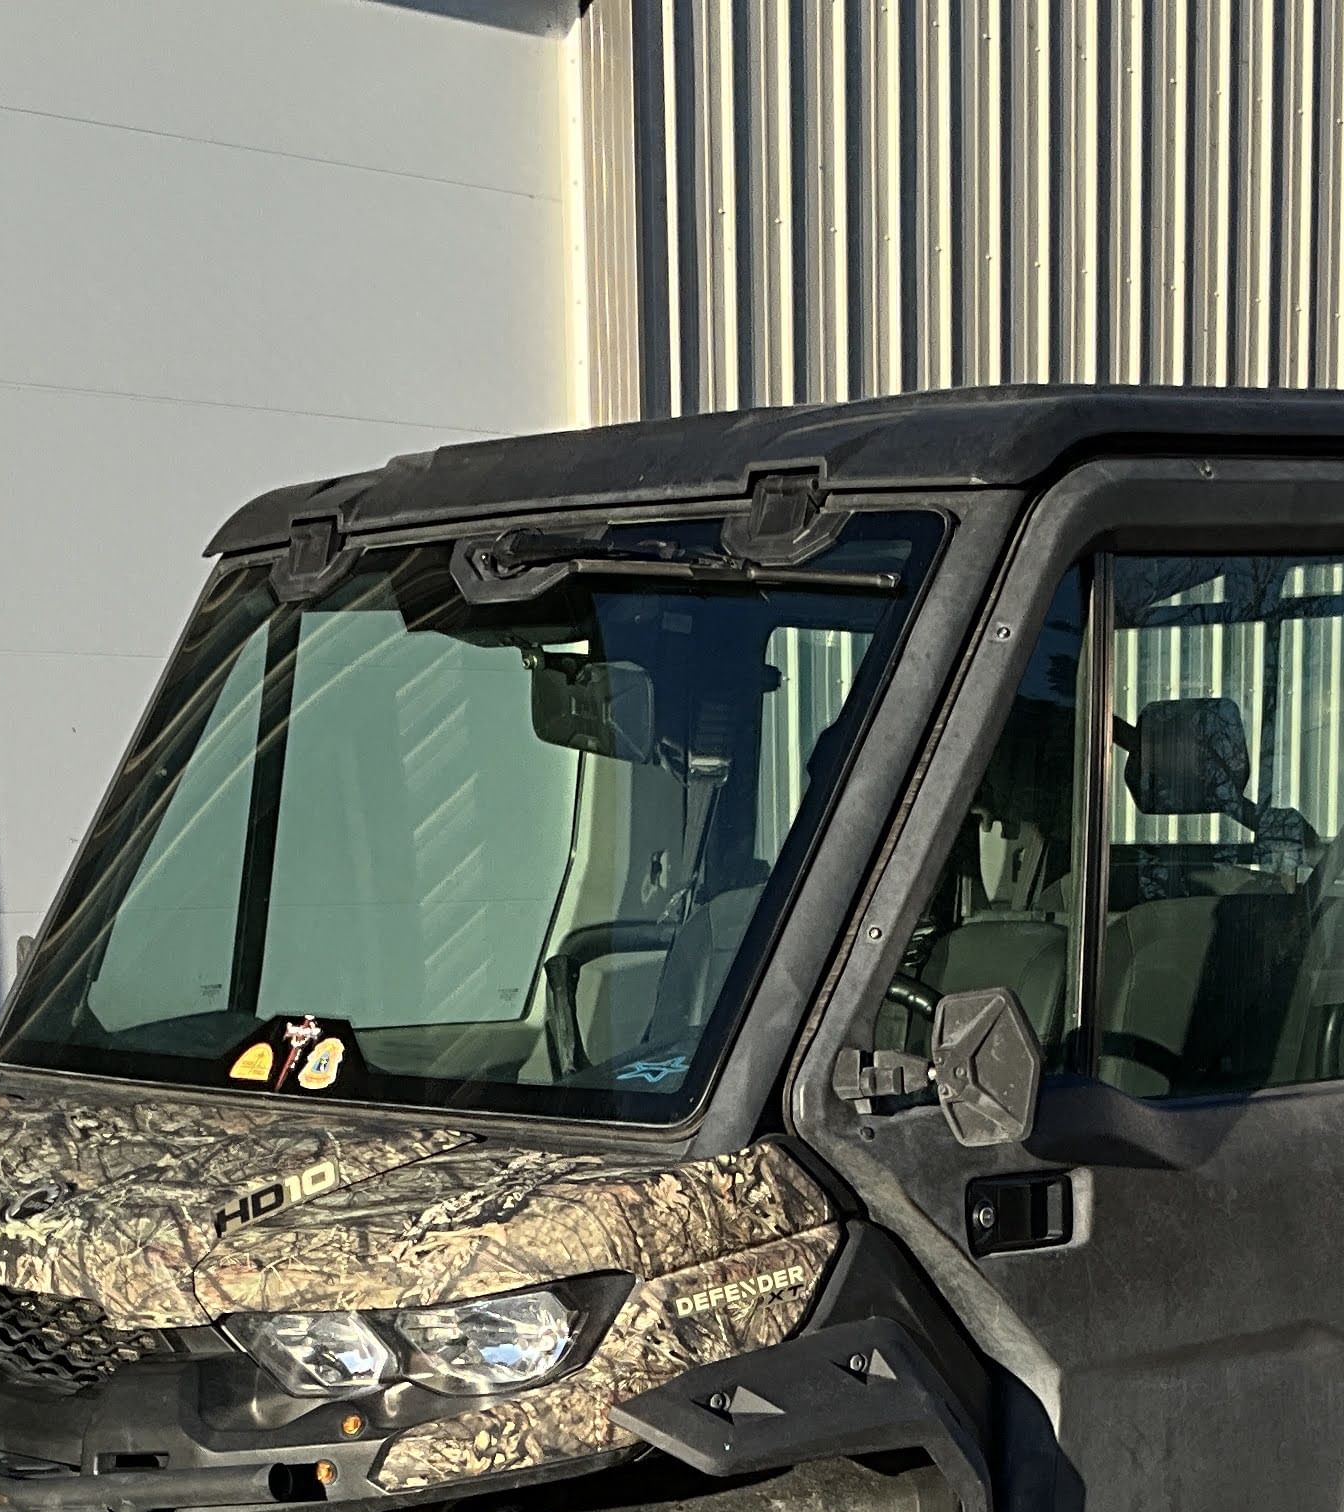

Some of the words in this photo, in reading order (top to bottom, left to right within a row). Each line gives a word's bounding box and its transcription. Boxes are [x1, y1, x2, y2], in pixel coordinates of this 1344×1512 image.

[214, 1160, 336, 1238] HD10
[675, 1265, 804, 1317] DEFENDER
[767, 1284, 804, 1305] XT
